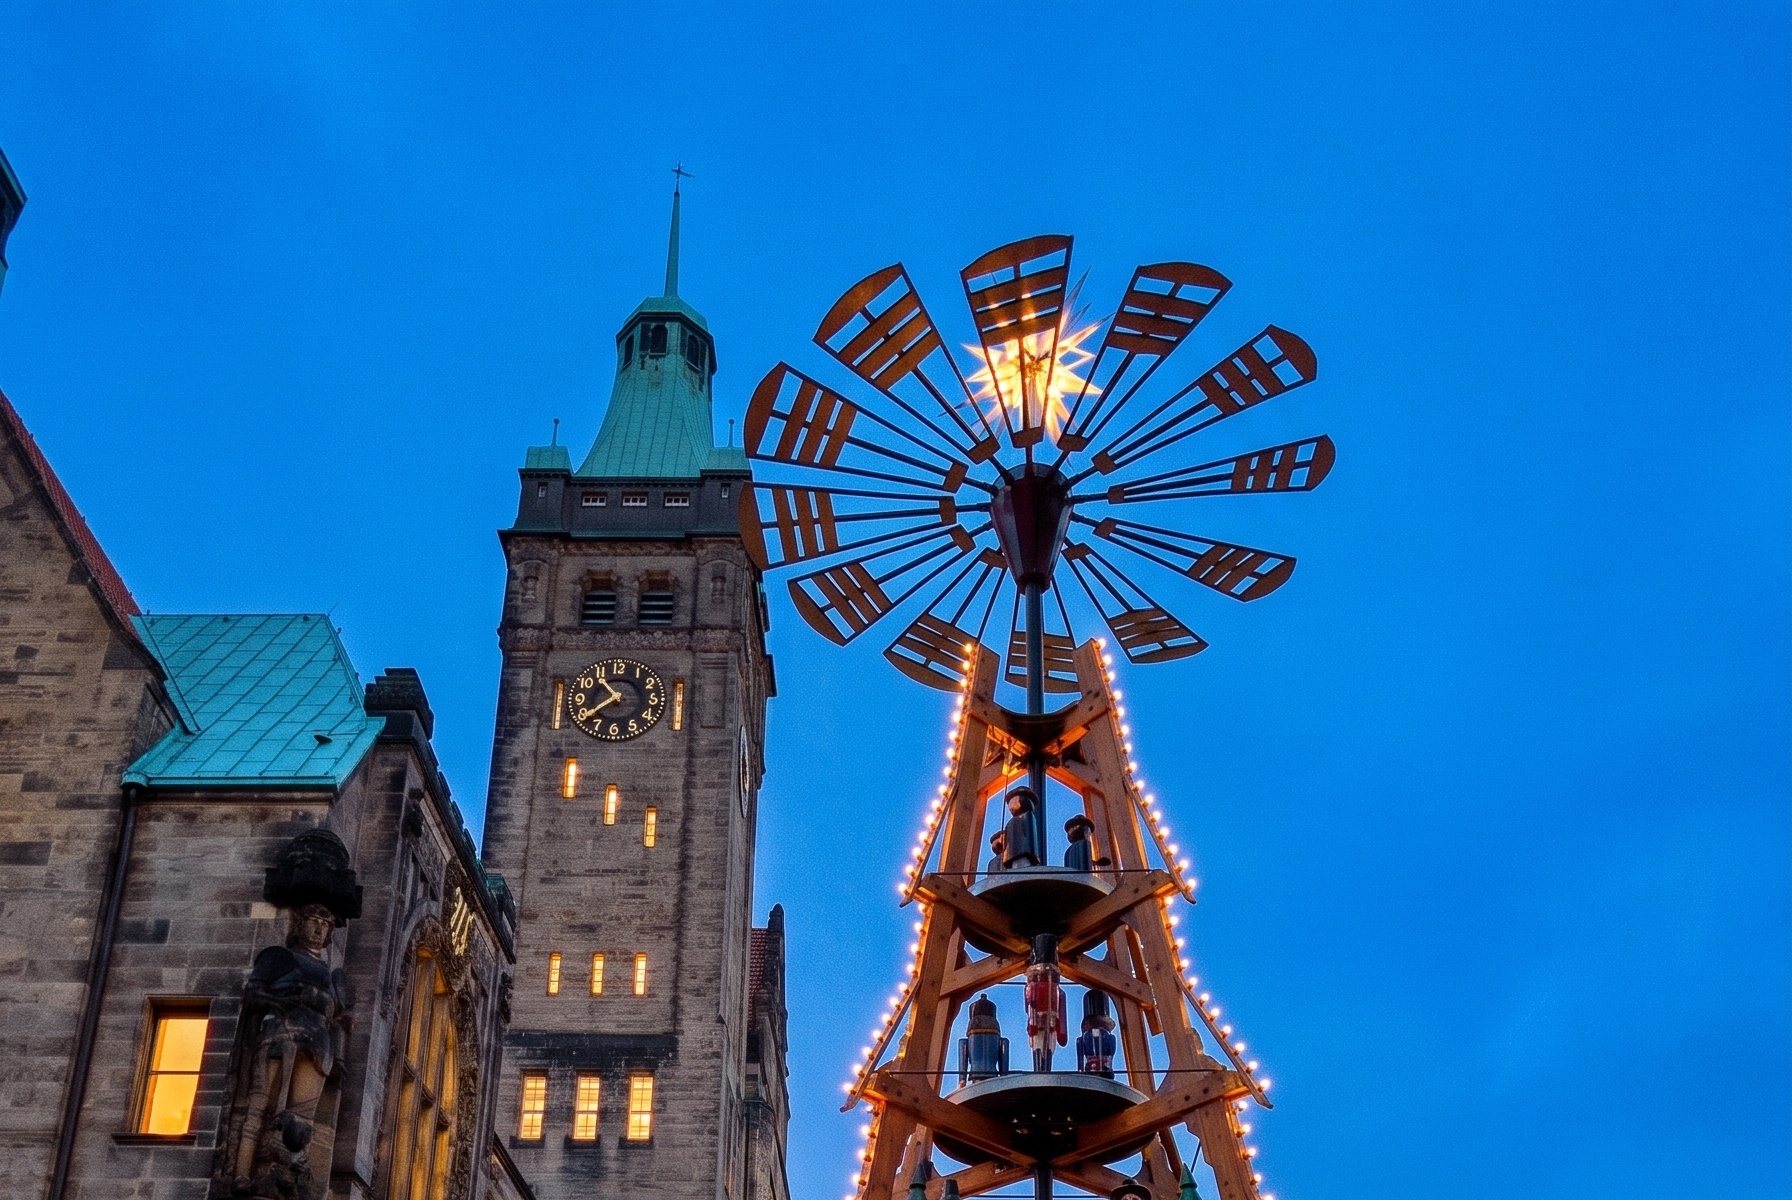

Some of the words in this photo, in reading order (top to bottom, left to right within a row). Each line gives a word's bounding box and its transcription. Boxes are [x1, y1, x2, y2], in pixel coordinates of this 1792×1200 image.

[596, 666, 605, 678] 11
[613, 663, 625, 674] 12
[635, 667, 640, 679] 1
[581, 677, 593, 688] 10
[646, 678, 654, 689] 2
[575, 694, 585, 705] 9
[578, 708, 588, 720] 8
[642, 708, 652, 720] 4
[593, 719, 602, 731] 7
[609, 723, 618, 735] 6
[628, 720, 637, 731] 5
